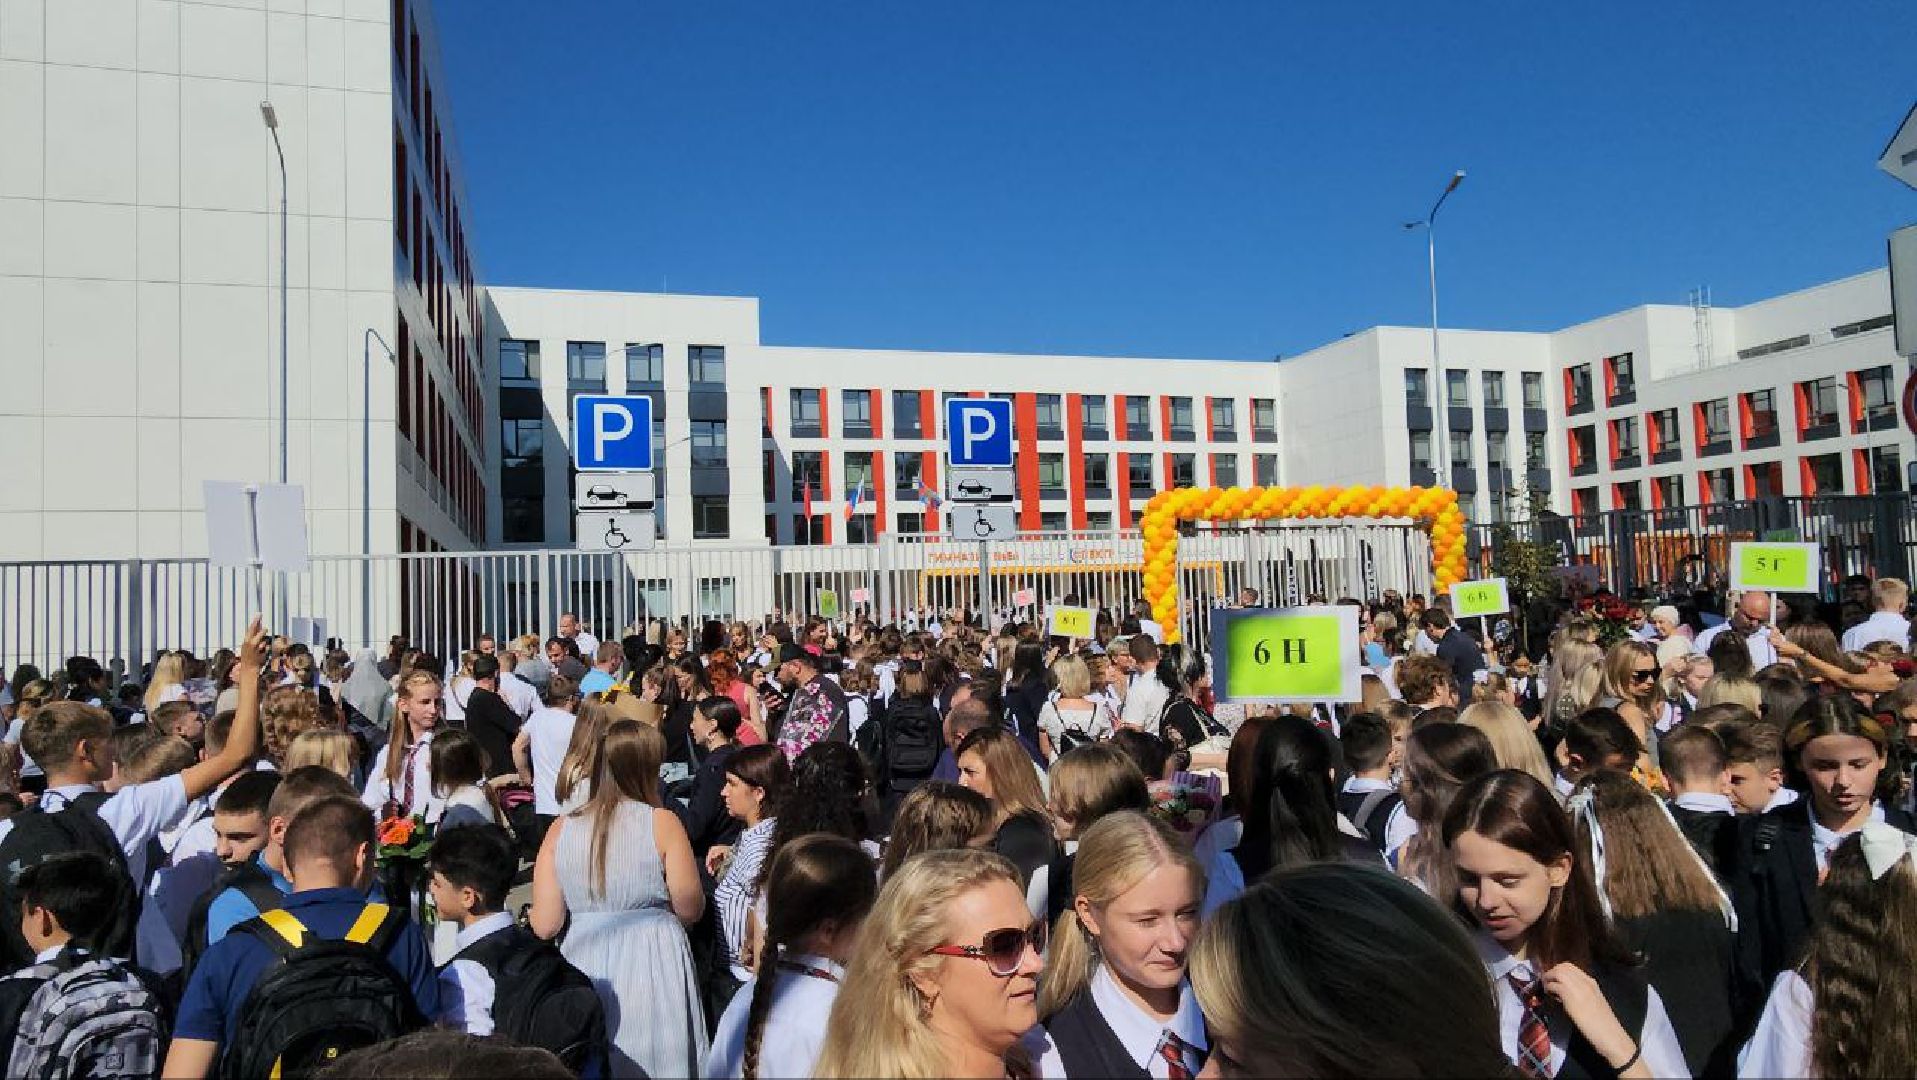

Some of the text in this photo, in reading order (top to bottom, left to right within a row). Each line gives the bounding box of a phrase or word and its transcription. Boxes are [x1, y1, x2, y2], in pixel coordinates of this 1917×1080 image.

[594, 403, 634, 462] P
[962, 407, 996, 460] P
[1755, 557, 1766, 571] 5
[1254, 638, 1312, 665] 6 Н
